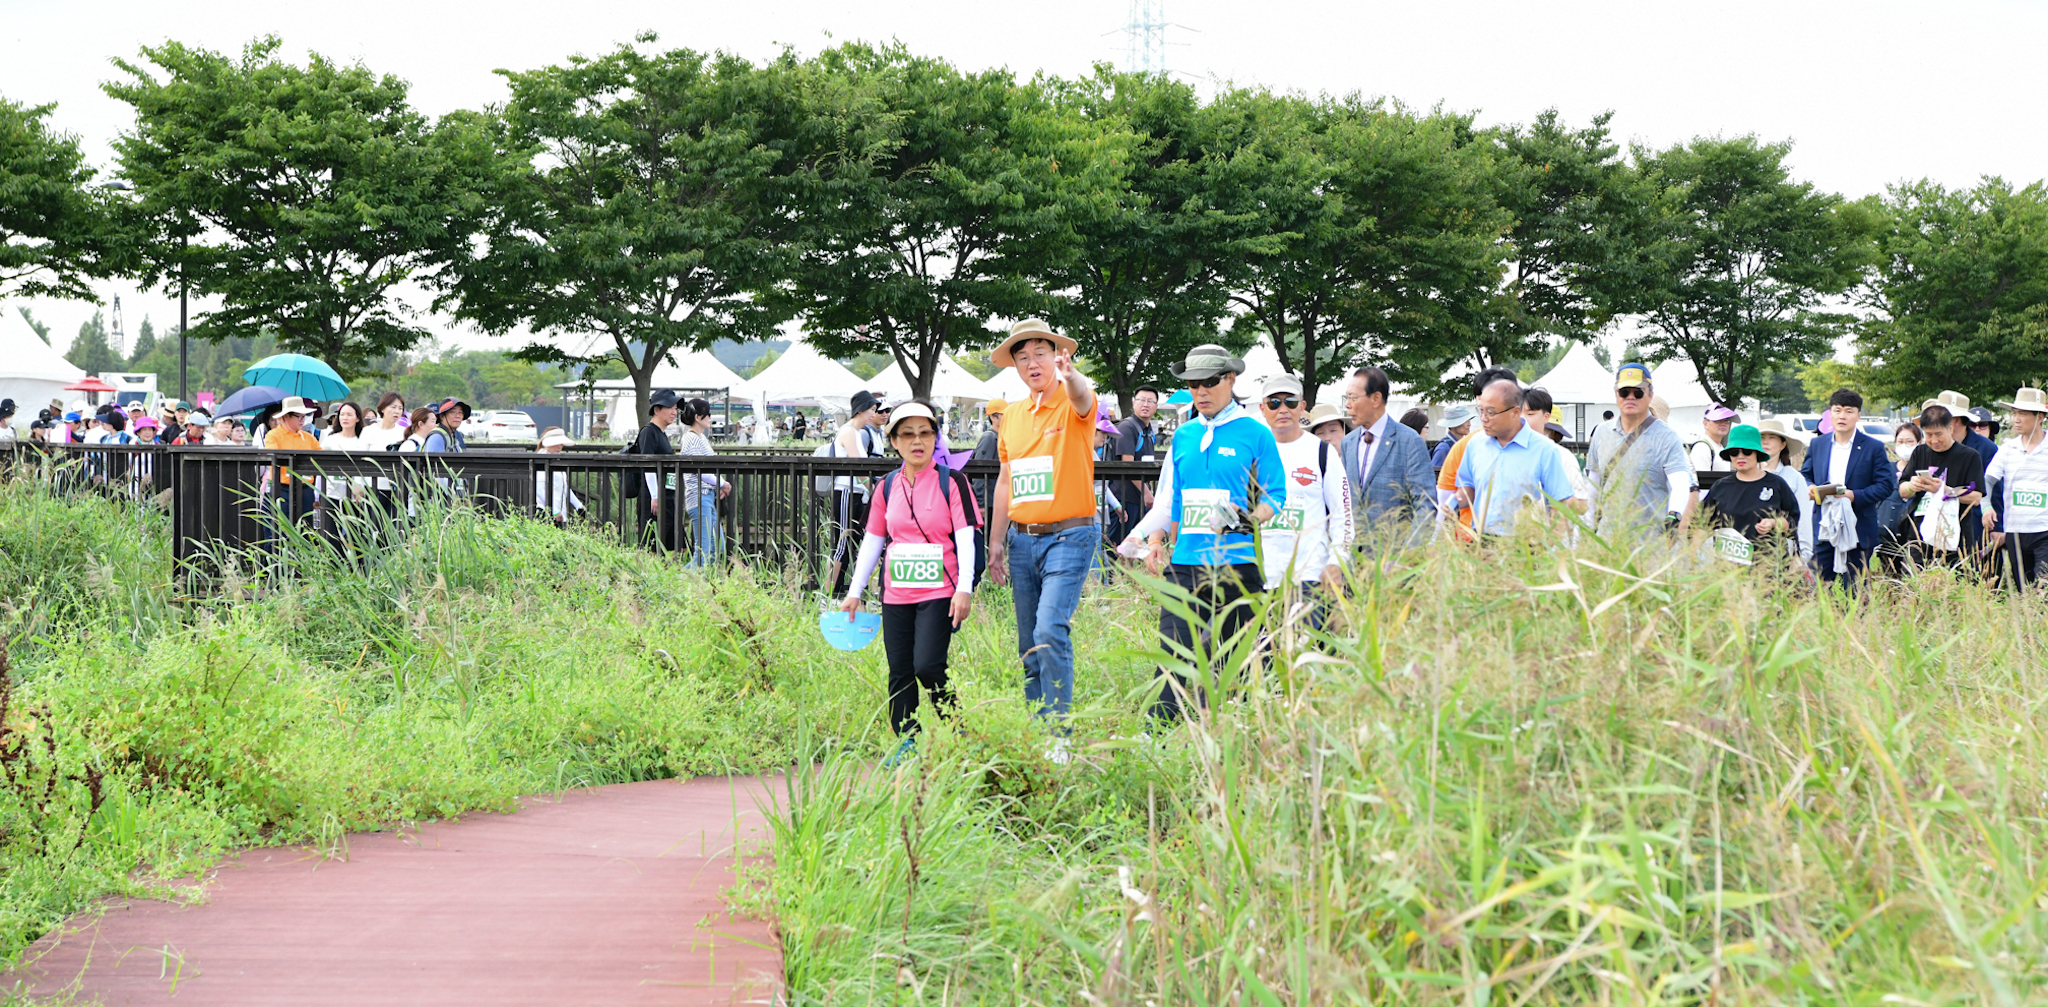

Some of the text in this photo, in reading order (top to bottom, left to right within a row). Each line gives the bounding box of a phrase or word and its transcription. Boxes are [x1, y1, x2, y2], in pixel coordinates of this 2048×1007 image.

[1013, 474, 1046, 496] 0001
[2015, 492, 2043, 506] 1029
[1184, 506, 1215, 526] 072
[1260, 510, 1300, 528] 745
[1721, 539, 1750, 558] 1865
[894, 561, 939, 580] 0788
